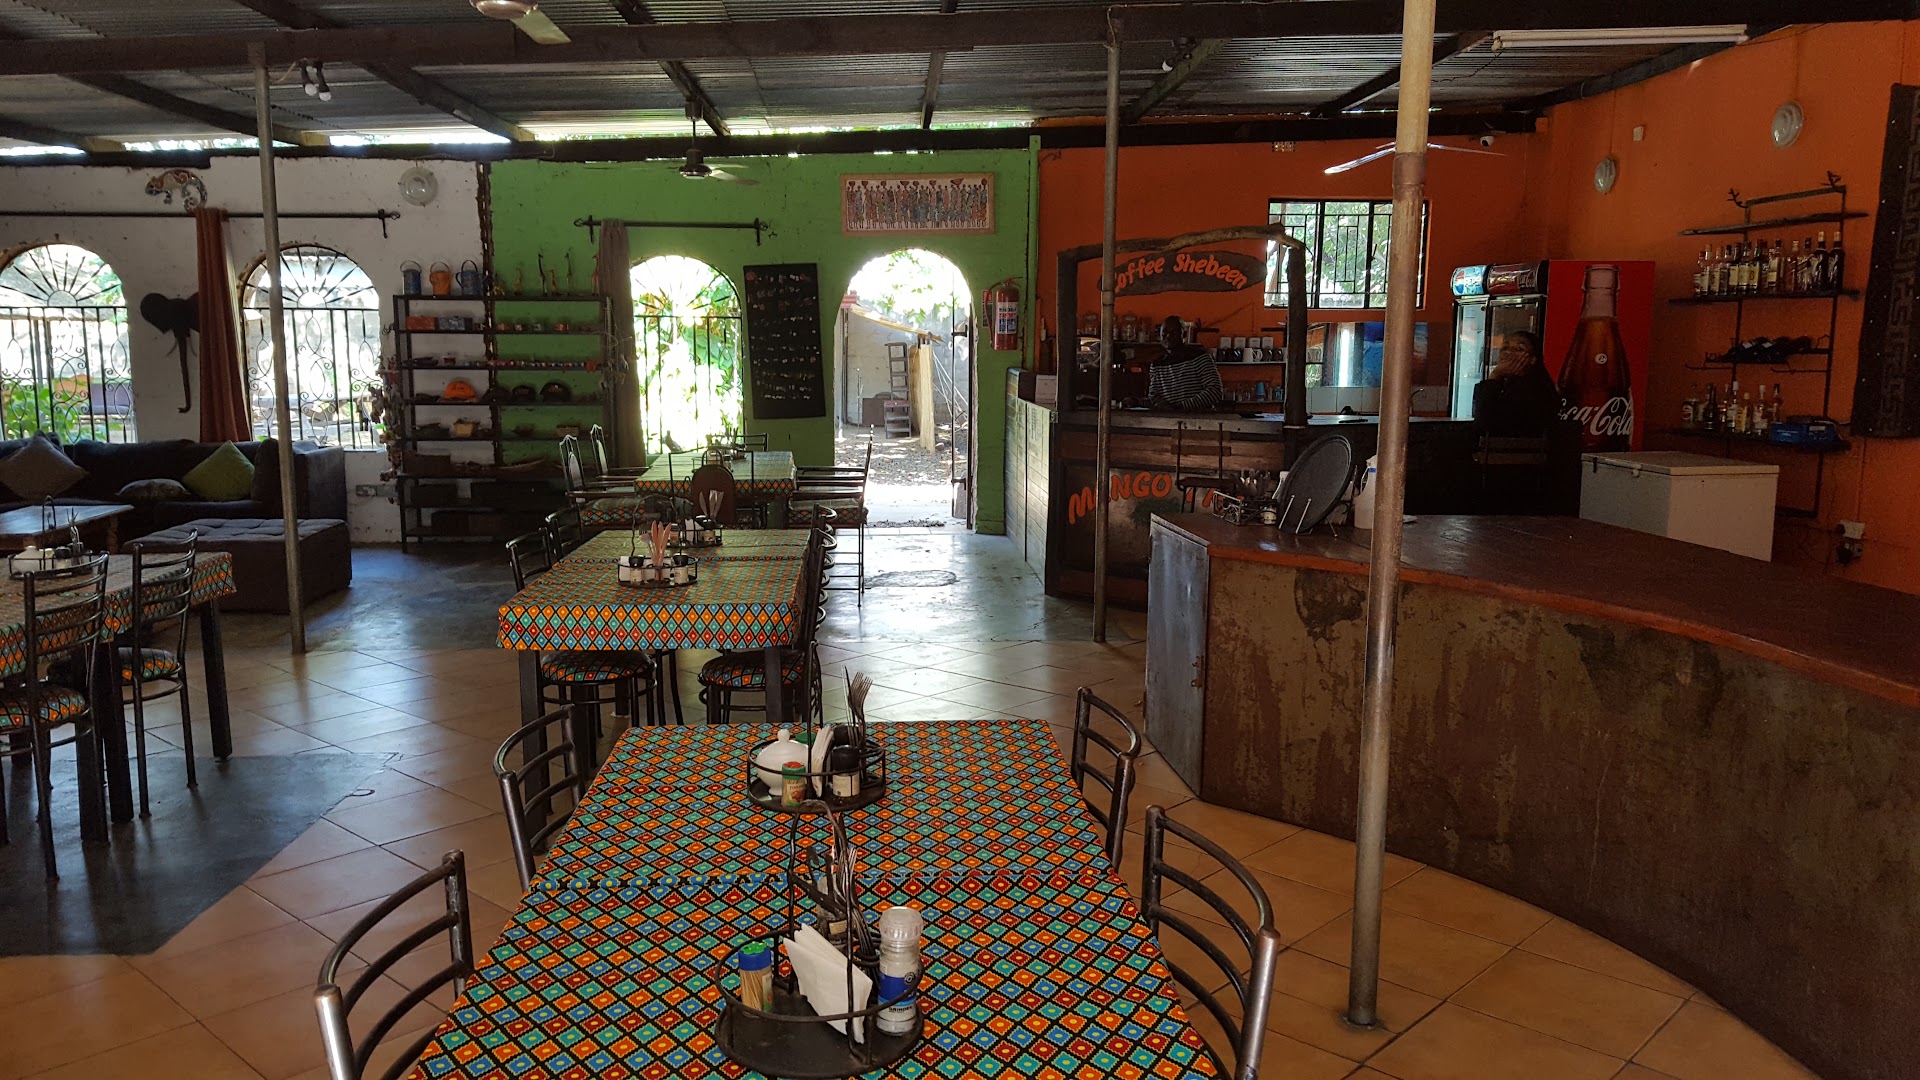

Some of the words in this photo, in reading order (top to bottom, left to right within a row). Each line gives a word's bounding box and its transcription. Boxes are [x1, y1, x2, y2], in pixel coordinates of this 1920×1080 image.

[1114, 257, 1166, 293] offee
[1173, 253, 1248, 289] Shebeen
[1068, 471, 1172, 525] MNGO
